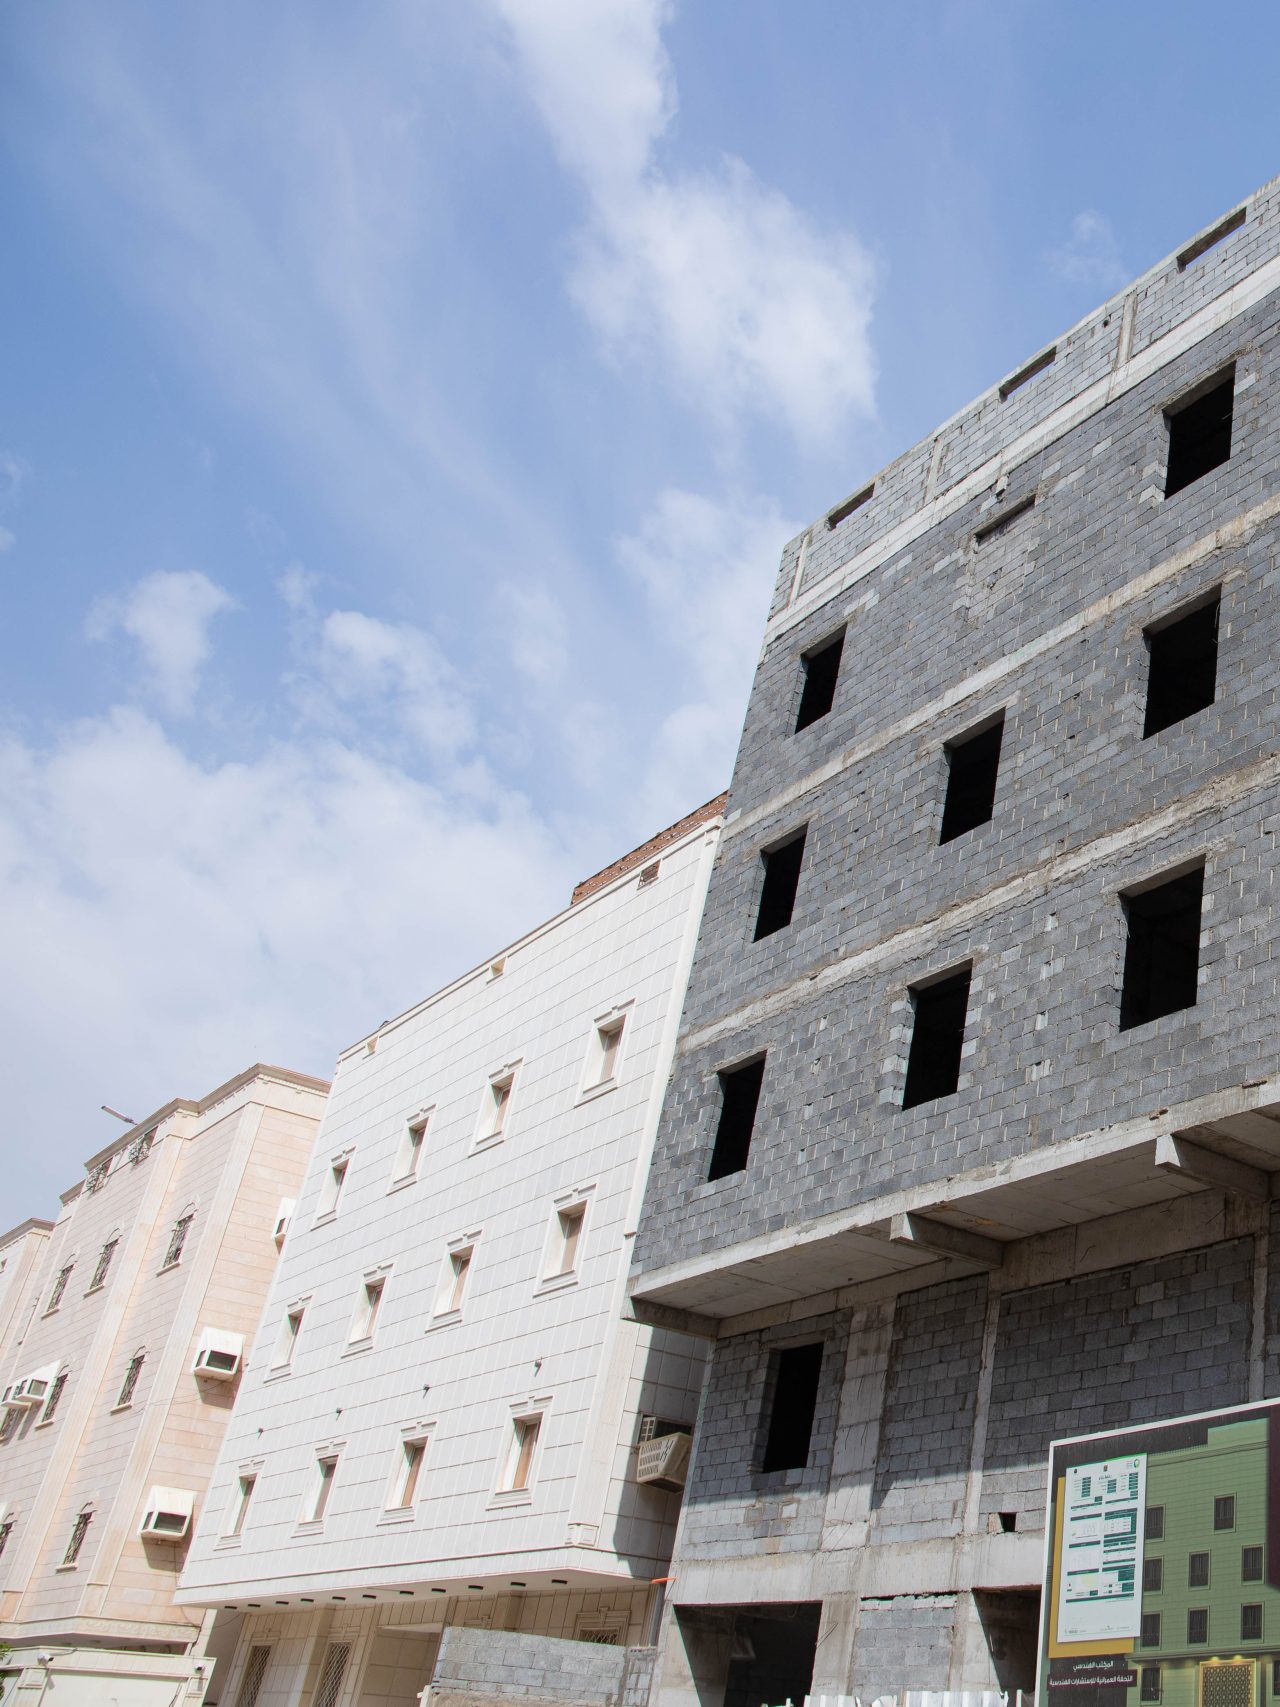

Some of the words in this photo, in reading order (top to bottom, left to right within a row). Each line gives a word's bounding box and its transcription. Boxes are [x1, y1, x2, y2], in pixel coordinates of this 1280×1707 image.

[1073, 1662, 1096, 1672] الهندسي
[1095, 1660, 1114, 1670] المكتب
[1049, 1677, 1071, 1687] الهندسية
